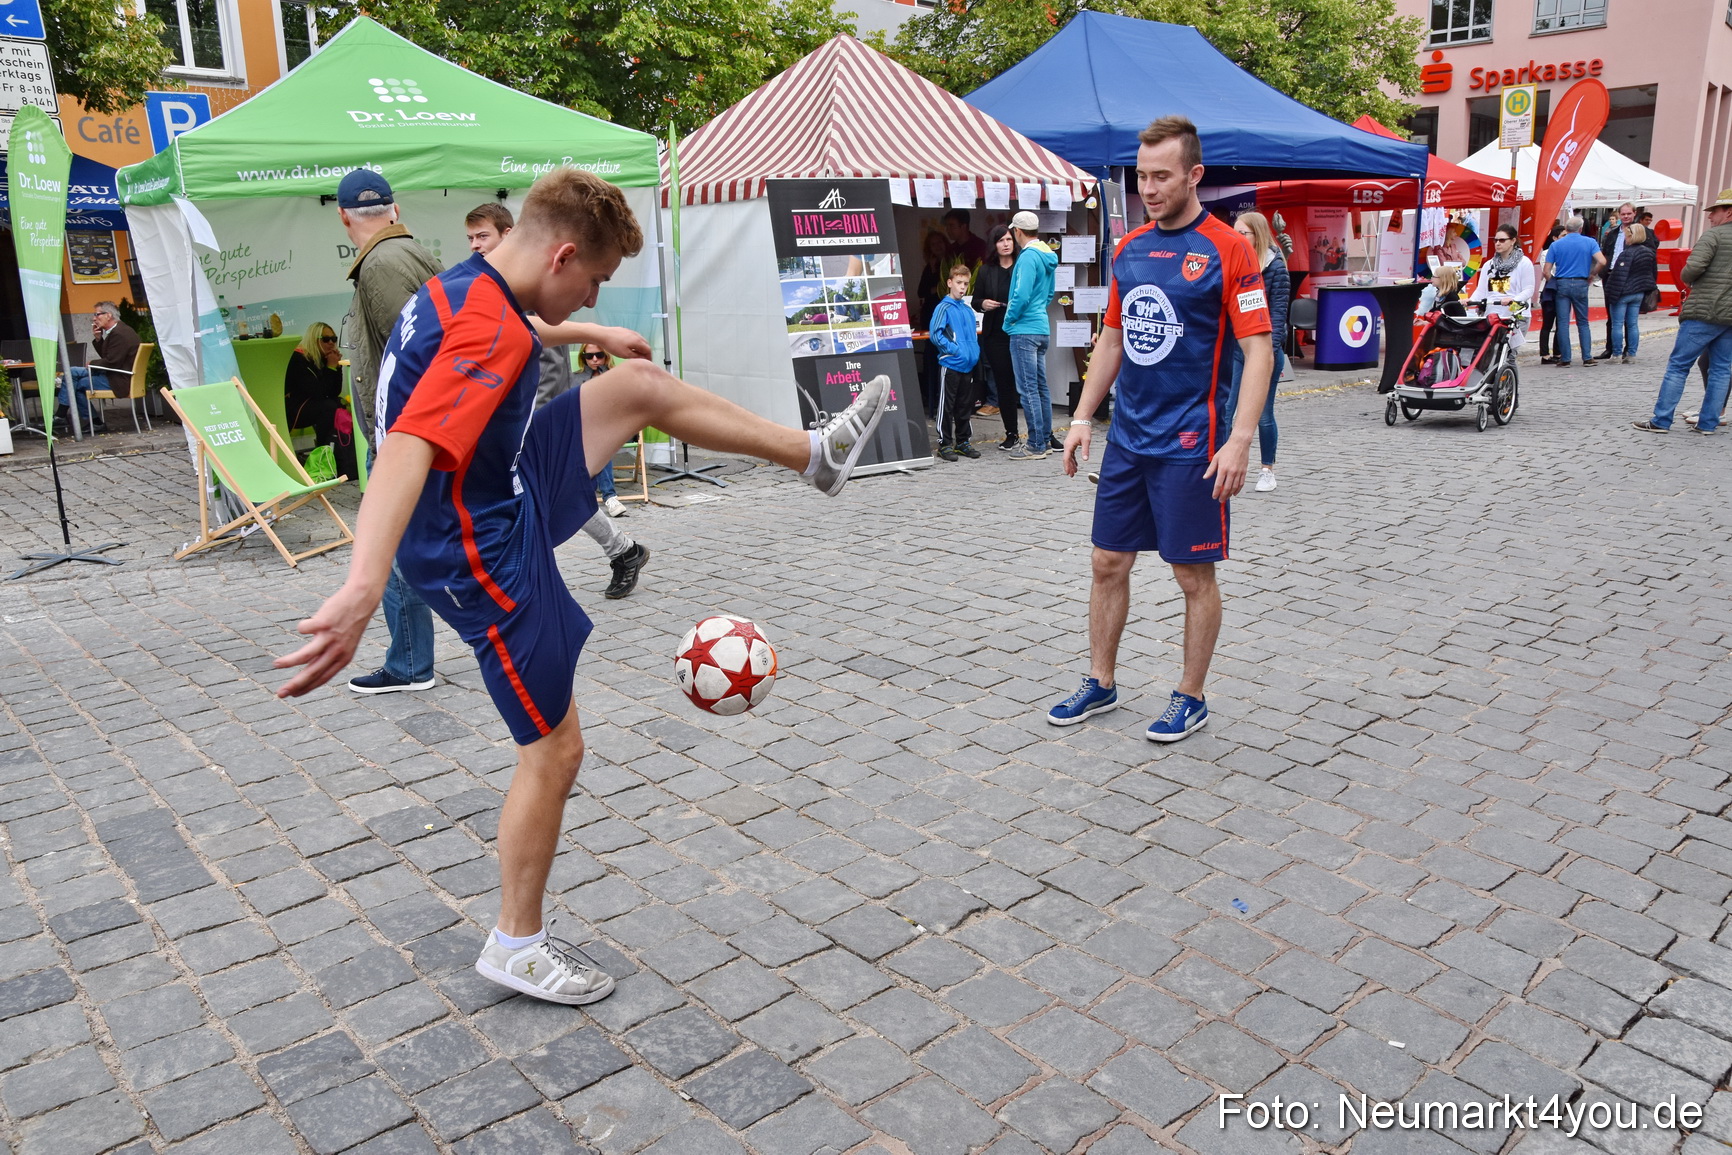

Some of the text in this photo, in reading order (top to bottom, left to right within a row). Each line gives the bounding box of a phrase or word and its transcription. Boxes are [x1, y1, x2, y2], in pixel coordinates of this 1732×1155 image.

[12, 46, 31, 57] mit
[1469, 58, 1604, 93] Sparkasse
[3, 82, 14, 92] Fr
[161, 101, 197, 146] P
[346, 109, 476, 123] Dr. Loew
[77, 116, 141, 145] Café
[397, 120, 481, 129] Dienstleistungen
[1551, 139, 1578, 183] LBS
[501, 156, 528, 173] Eine
[532, 159, 556, 182] gute
[18, 172, 61, 193] Dr. Loew
[1353, 189, 1384, 204] LBS
[1425, 190, 1441, 203] LBS
[20, 216, 33, 231] Eine
[799, 237, 876, 247] ZEITARBEIT
[221, 241, 252, 271] gute
[1148, 250, 1177, 259] saller
[204, 249, 293, 290] Perspektive!
[880, 302, 902, 313] suche
[845, 361, 861, 370] Ihre
[826, 370, 862, 385] Arbeit
[849, 384, 860, 392] ist
[208, 429, 246, 446] LIEGE
